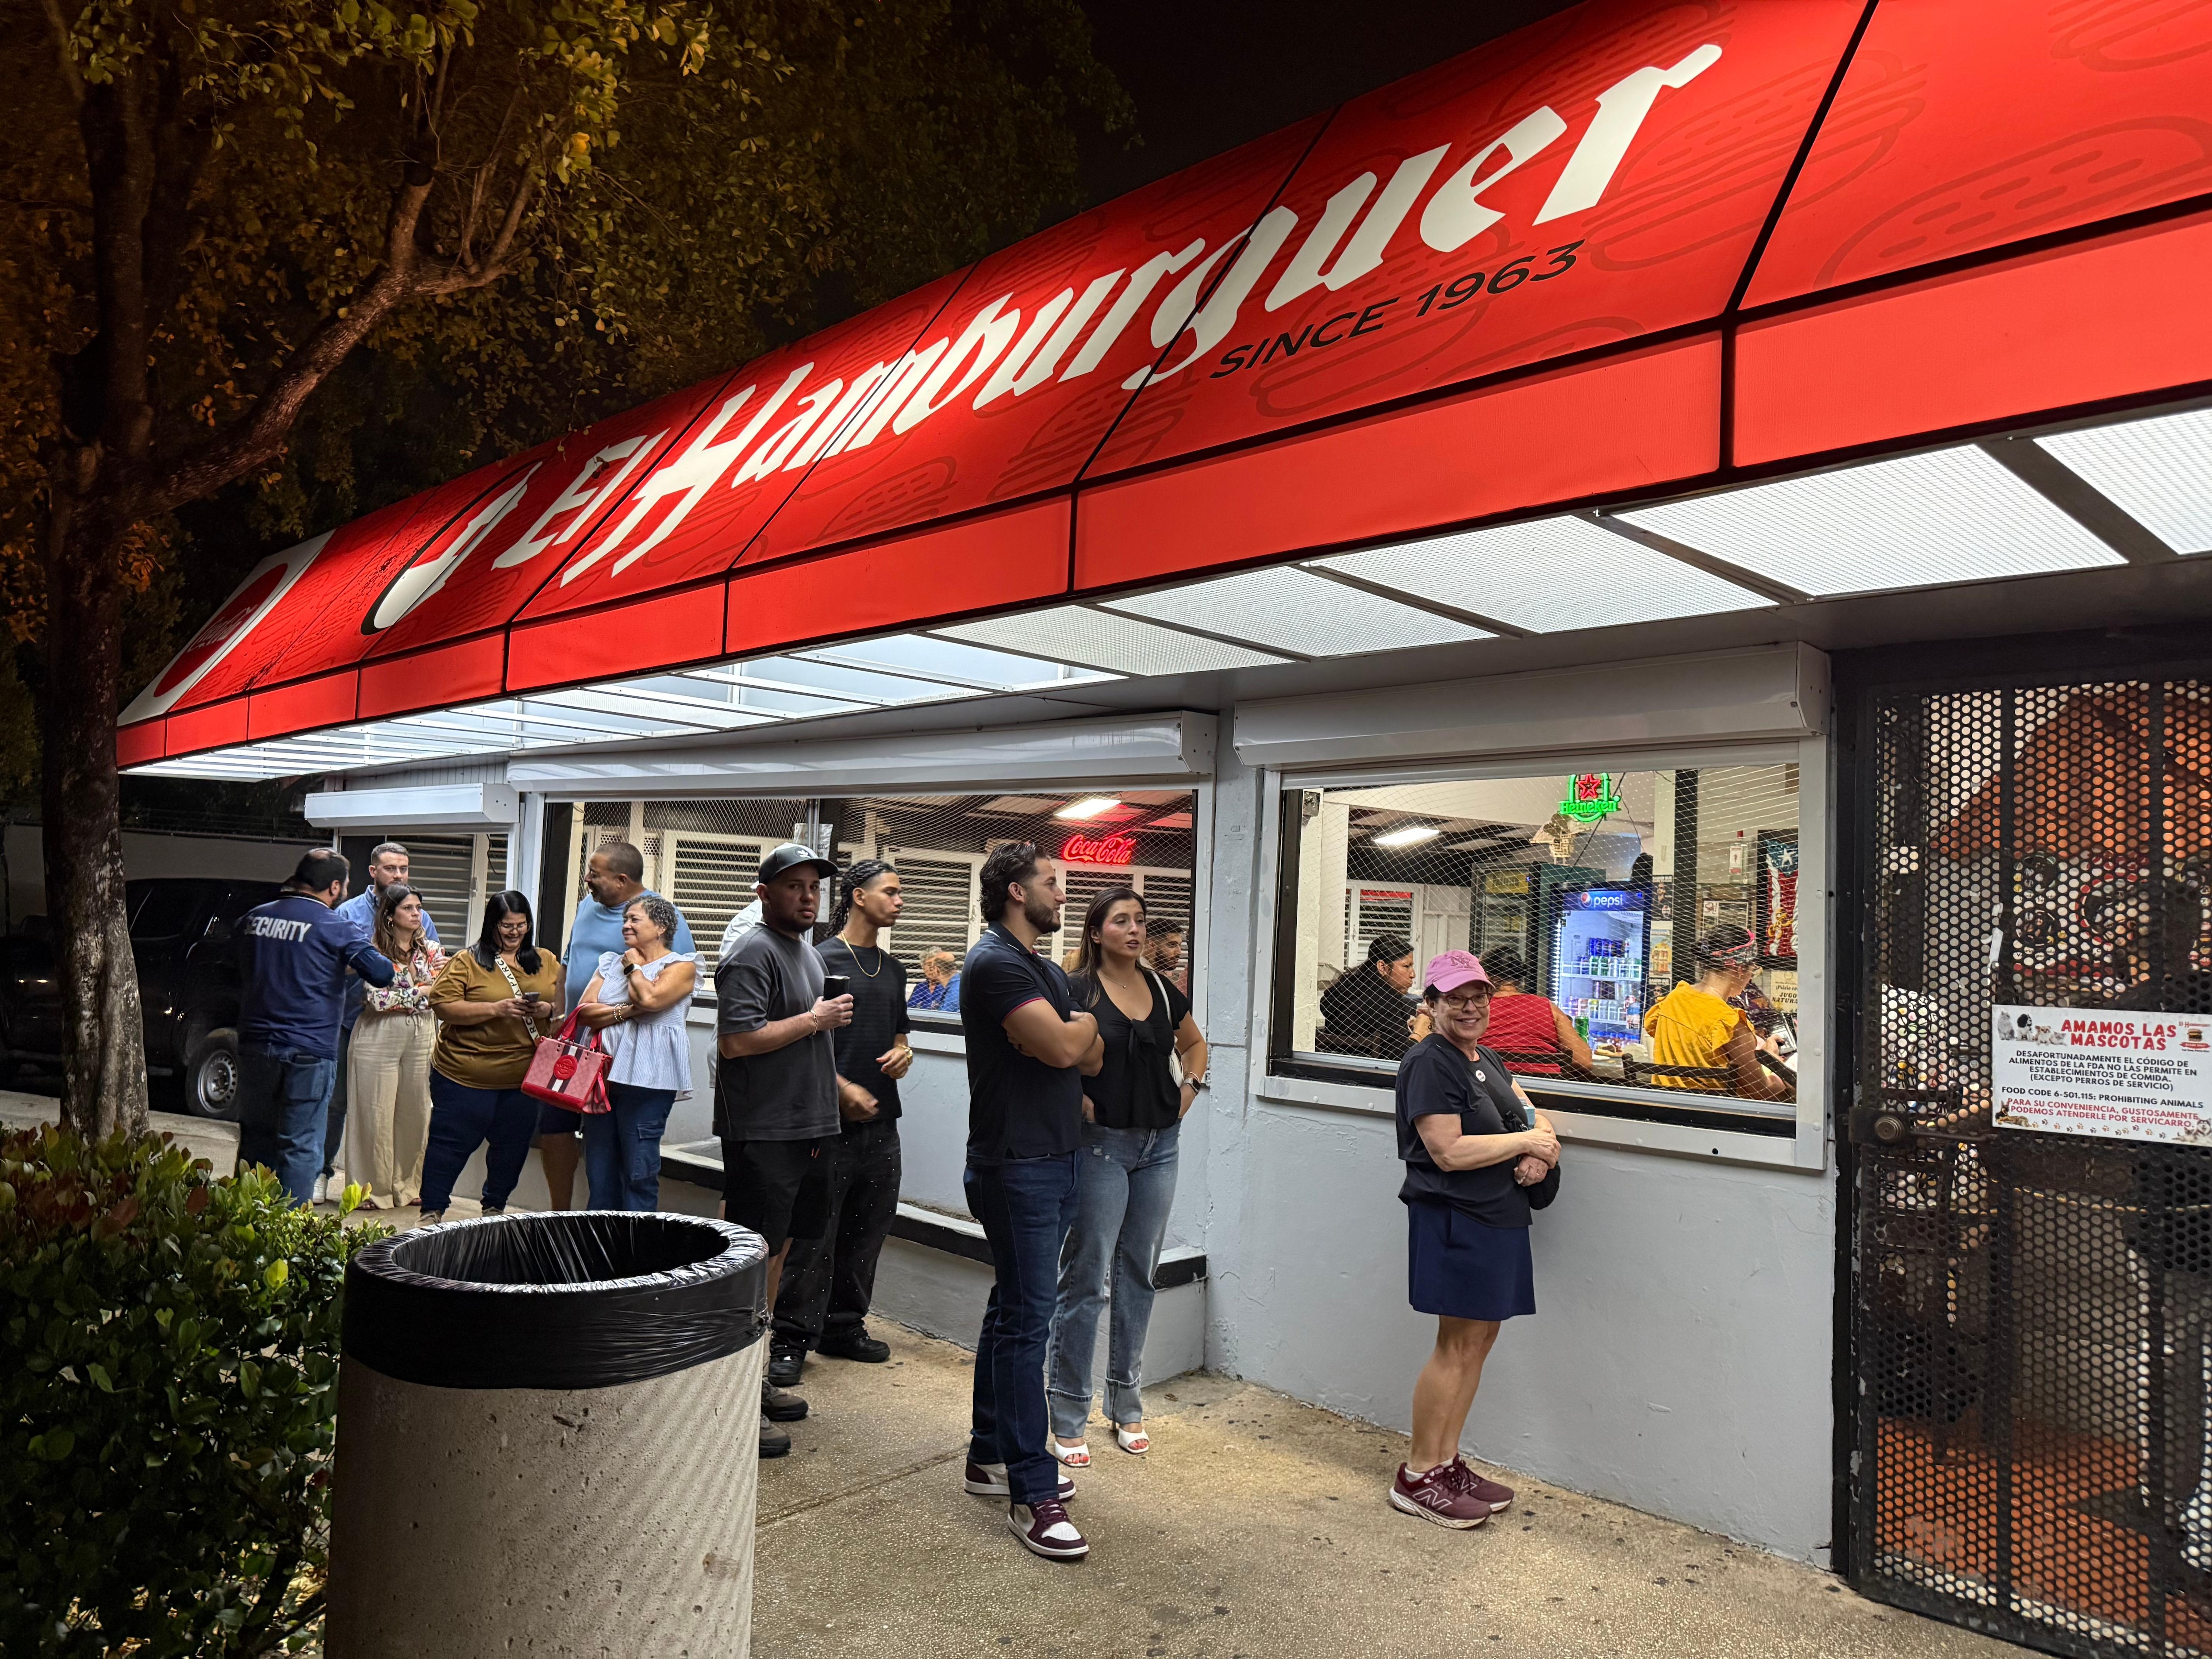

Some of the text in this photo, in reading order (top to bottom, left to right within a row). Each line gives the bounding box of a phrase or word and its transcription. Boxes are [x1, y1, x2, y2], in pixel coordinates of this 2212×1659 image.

[492, 43, 1722, 588] El Hamburguer
[1209, 239, 1585, 379] SINCE 1963
[1559, 799, 1618, 815] Heineken
[1064, 834, 1136, 863] Coca-Cola
[1594, 894, 1623, 908] pepsi
[244, 913, 312, 942] SECURITY
[1447, 956, 1475, 969] NY
[2061, 1019, 2134, 1035] AMAMOS
[2143, 1023, 2176, 1037] LAS
[2070, 1033, 2166, 1051] MASCOTAS
[2008, 1057, 2058, 1067] ALIMENTOS
[2143, 1066, 2182, 1075] PERMITE
[2016, 1050, 2122, 1063] DESAFORTUNADAMENTE
[2136, 1056, 2174, 1066] CÓDIGO
[2029, 1066, 2114, 1078] ESTABLECIMIENTOS
[2131, 1073, 2172, 1082] COMIDA.
[2031, 1074, 2073, 1083] (EXCEPTO
[2075, 1077, 2110, 1085] PERROS
[2127, 1080, 2174, 1092] SERVICIO)
[2054, 1091, 2096, 1100] 6-501.115:
[2099, 1094, 2158, 1105] PROHIBITING
[2160, 1099, 2204, 1108] ANIMALS
[2011, 1106, 2054, 1115] PODEMOS
[2056, 1110, 2106, 1120] ATENDERLE
[2131, 1116, 2195, 1128] SERVICARRO.
[2047, 1101, 2119, 1114] CONVENIENCIA,
[2122, 1107, 2199, 1120] GUSTOSAMENTE
